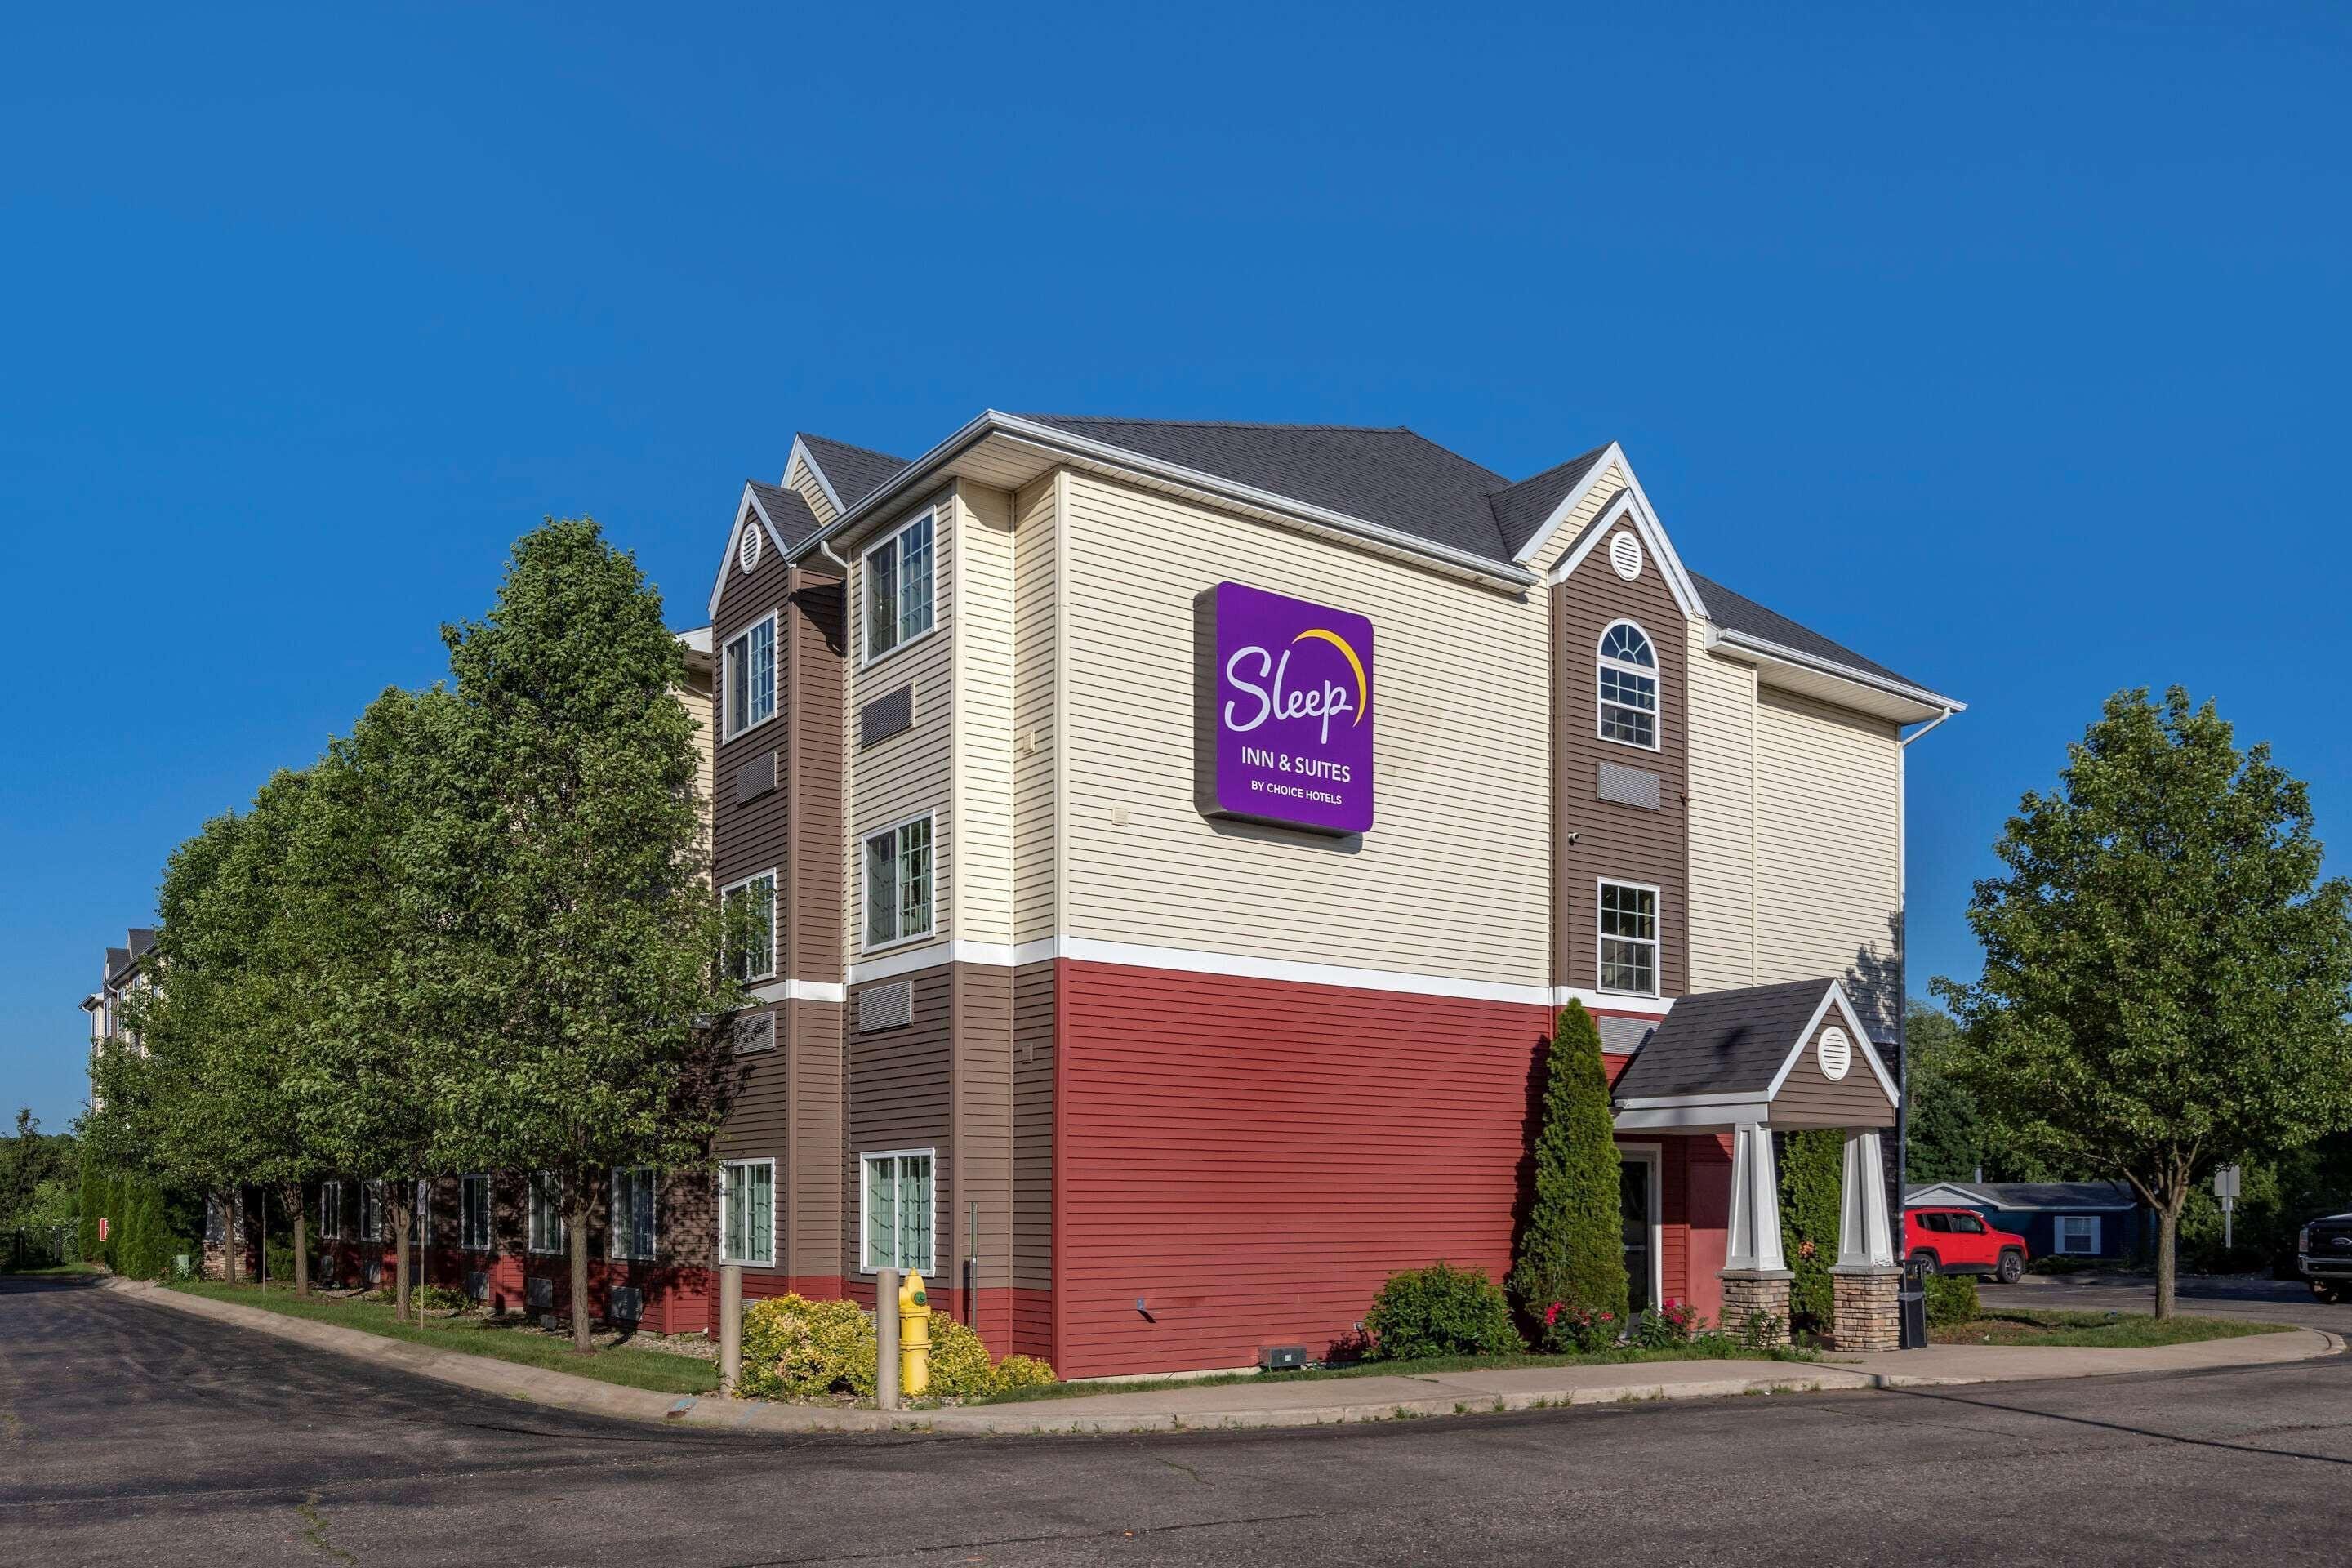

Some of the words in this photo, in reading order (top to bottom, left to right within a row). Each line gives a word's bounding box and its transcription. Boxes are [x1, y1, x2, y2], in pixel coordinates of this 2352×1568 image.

[1224, 646, 1353, 744] Sleep
[1242, 746, 1274, 768] INN
[1279, 754, 1291, 772] &
[1295, 757, 1351, 782] SUITES
[1251, 780, 1264, 791] BY
[1267, 783, 1303, 799] CHOICE
[1306, 790, 1342, 804] HOTELS
